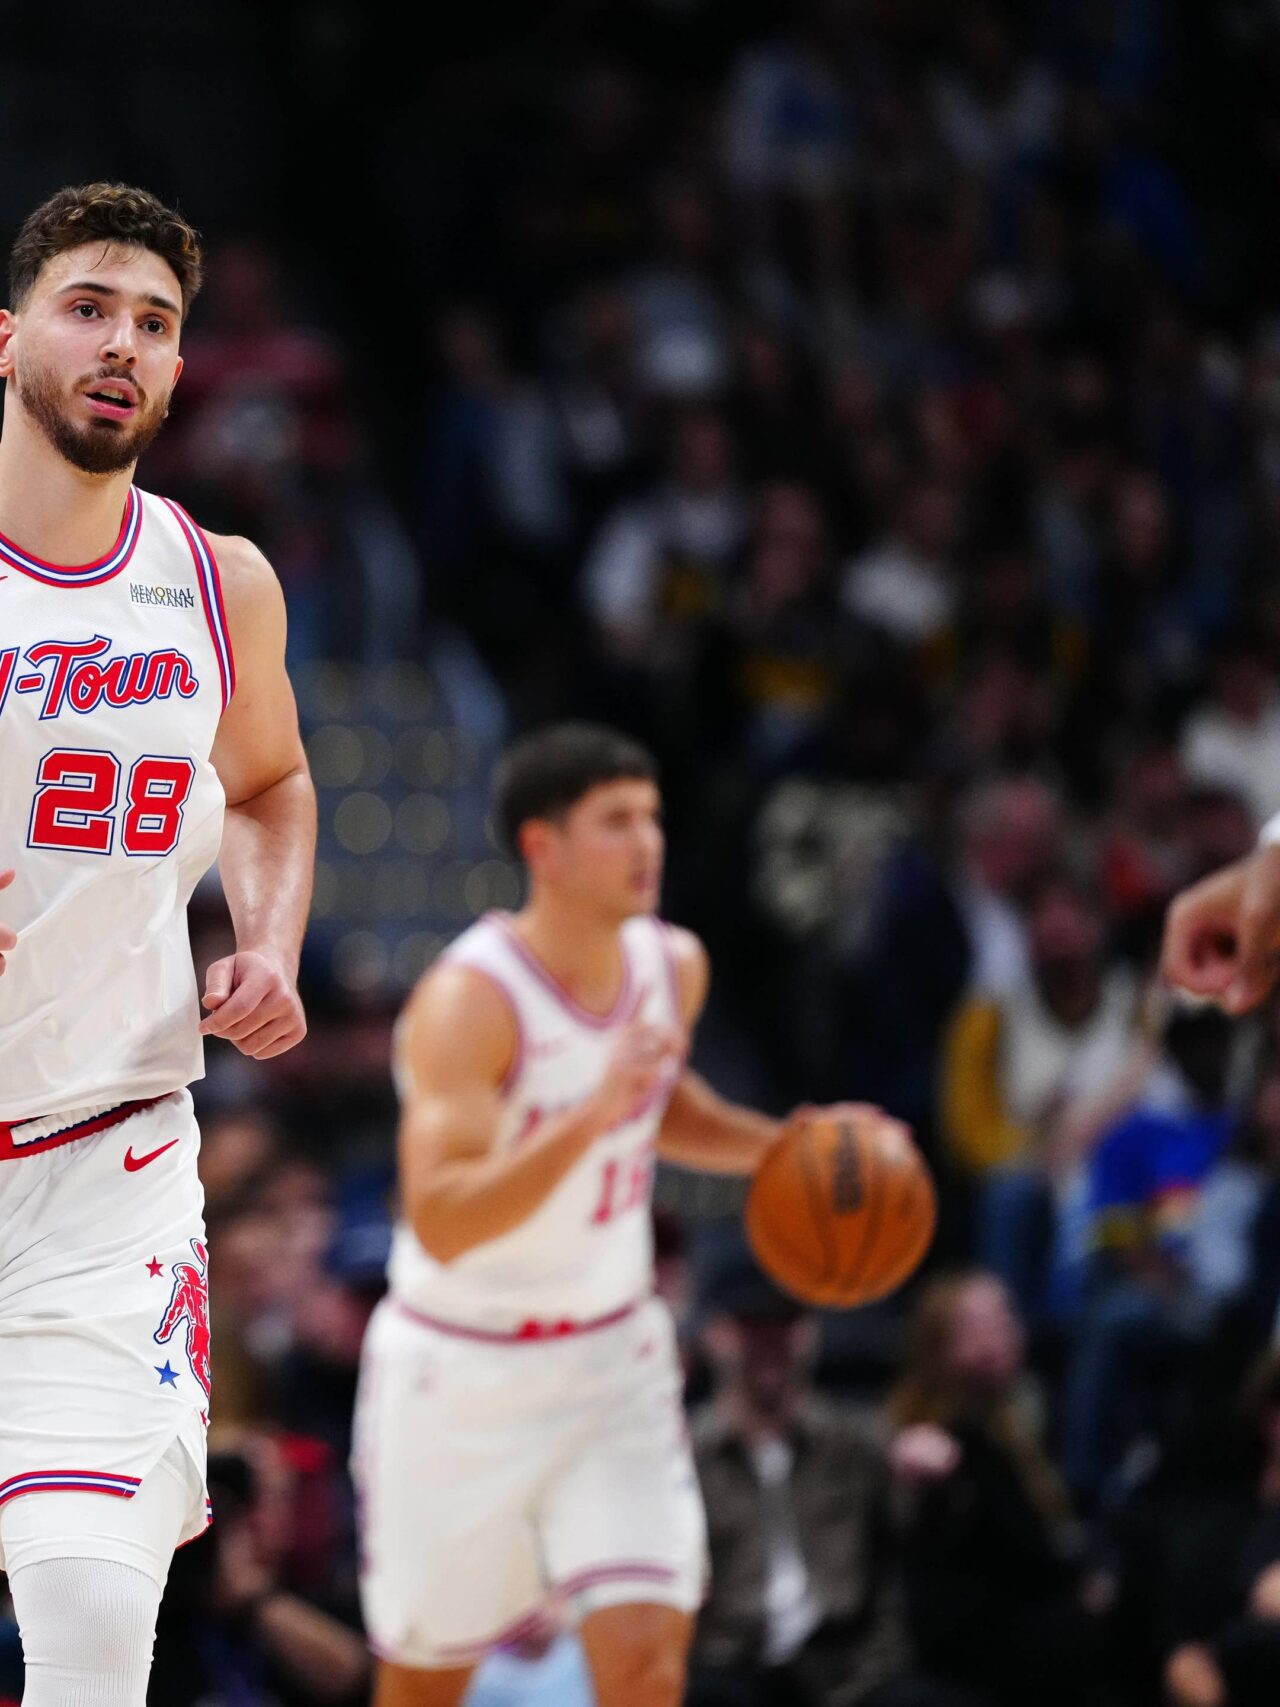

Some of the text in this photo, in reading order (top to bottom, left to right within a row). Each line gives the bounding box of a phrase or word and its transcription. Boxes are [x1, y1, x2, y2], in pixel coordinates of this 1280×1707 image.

[129, 582, 195, 599] MEMORIAL
[131, 592, 195, 608] HERMANN
[26, 747, 196, 857] 28
